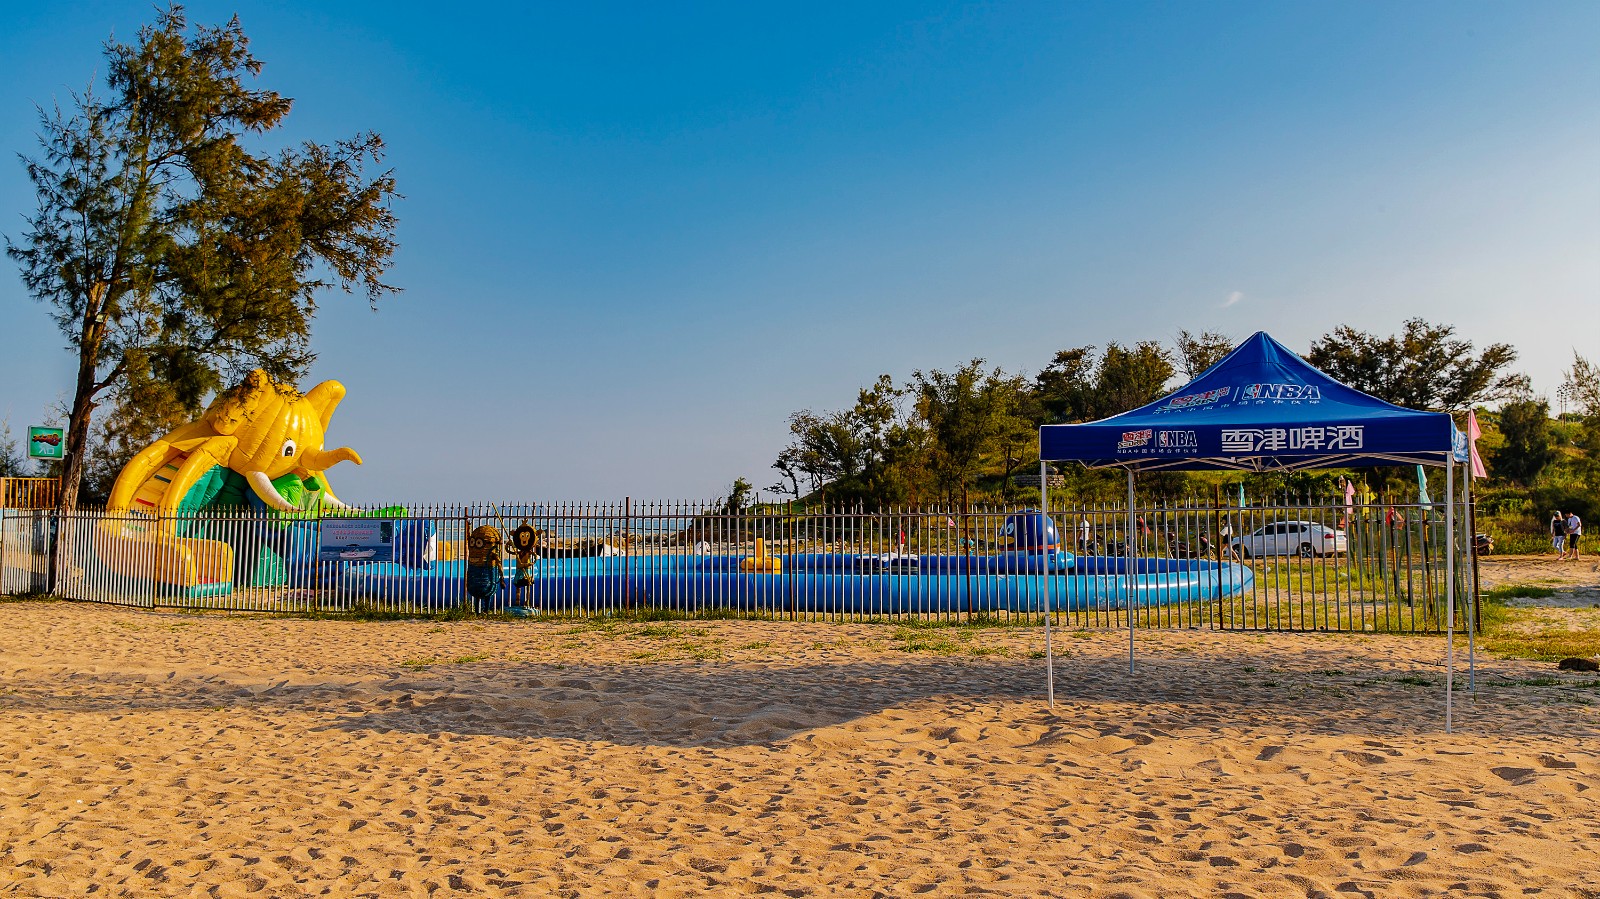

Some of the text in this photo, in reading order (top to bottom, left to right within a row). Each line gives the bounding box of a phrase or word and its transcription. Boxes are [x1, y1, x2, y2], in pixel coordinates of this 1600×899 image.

[1257, 383, 1321, 399] NBA
[1167, 430, 1198, 447] NBA
[1221, 425, 1365, 451] 雪津啤酒
